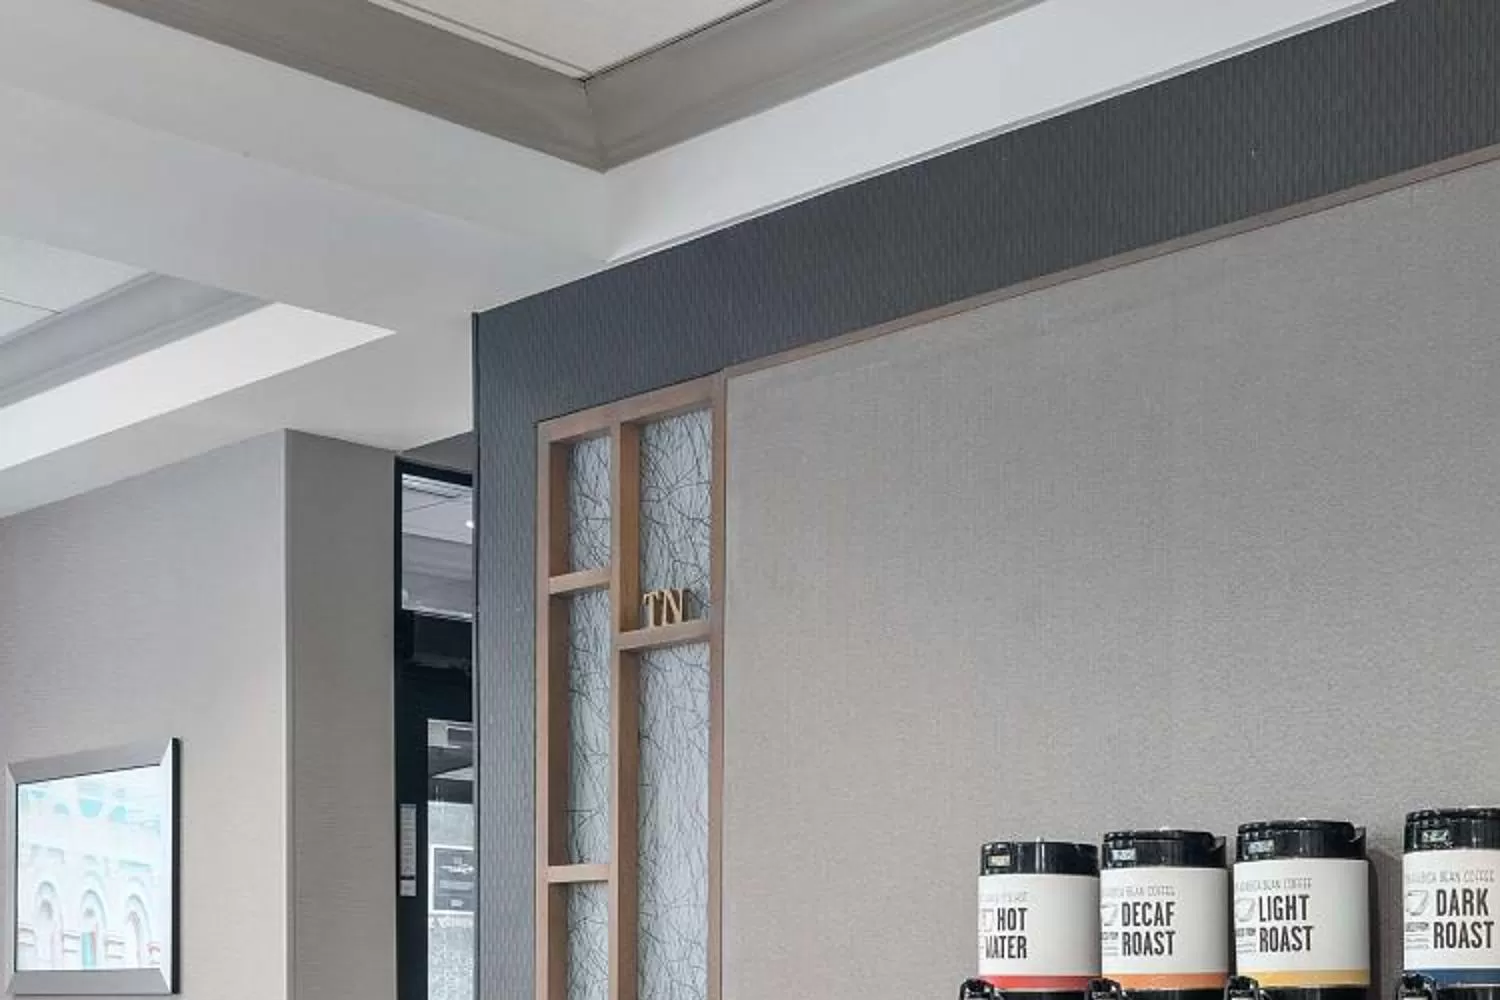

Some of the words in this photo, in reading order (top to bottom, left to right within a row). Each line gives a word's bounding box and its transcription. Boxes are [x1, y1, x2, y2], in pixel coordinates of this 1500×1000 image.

[1121, 901, 1176, 927] DECAF
[1259, 894, 1310, 922] LIGHT
[1436, 888, 1489, 916] DARK
[997, 907, 1028, 931] HOT
[984, 935, 1028, 959] WATER
[1121, 931, 1176, 956] ROAST
[1259, 925, 1314, 953] ROAST
[1433, 921, 1495, 949] ROAST
